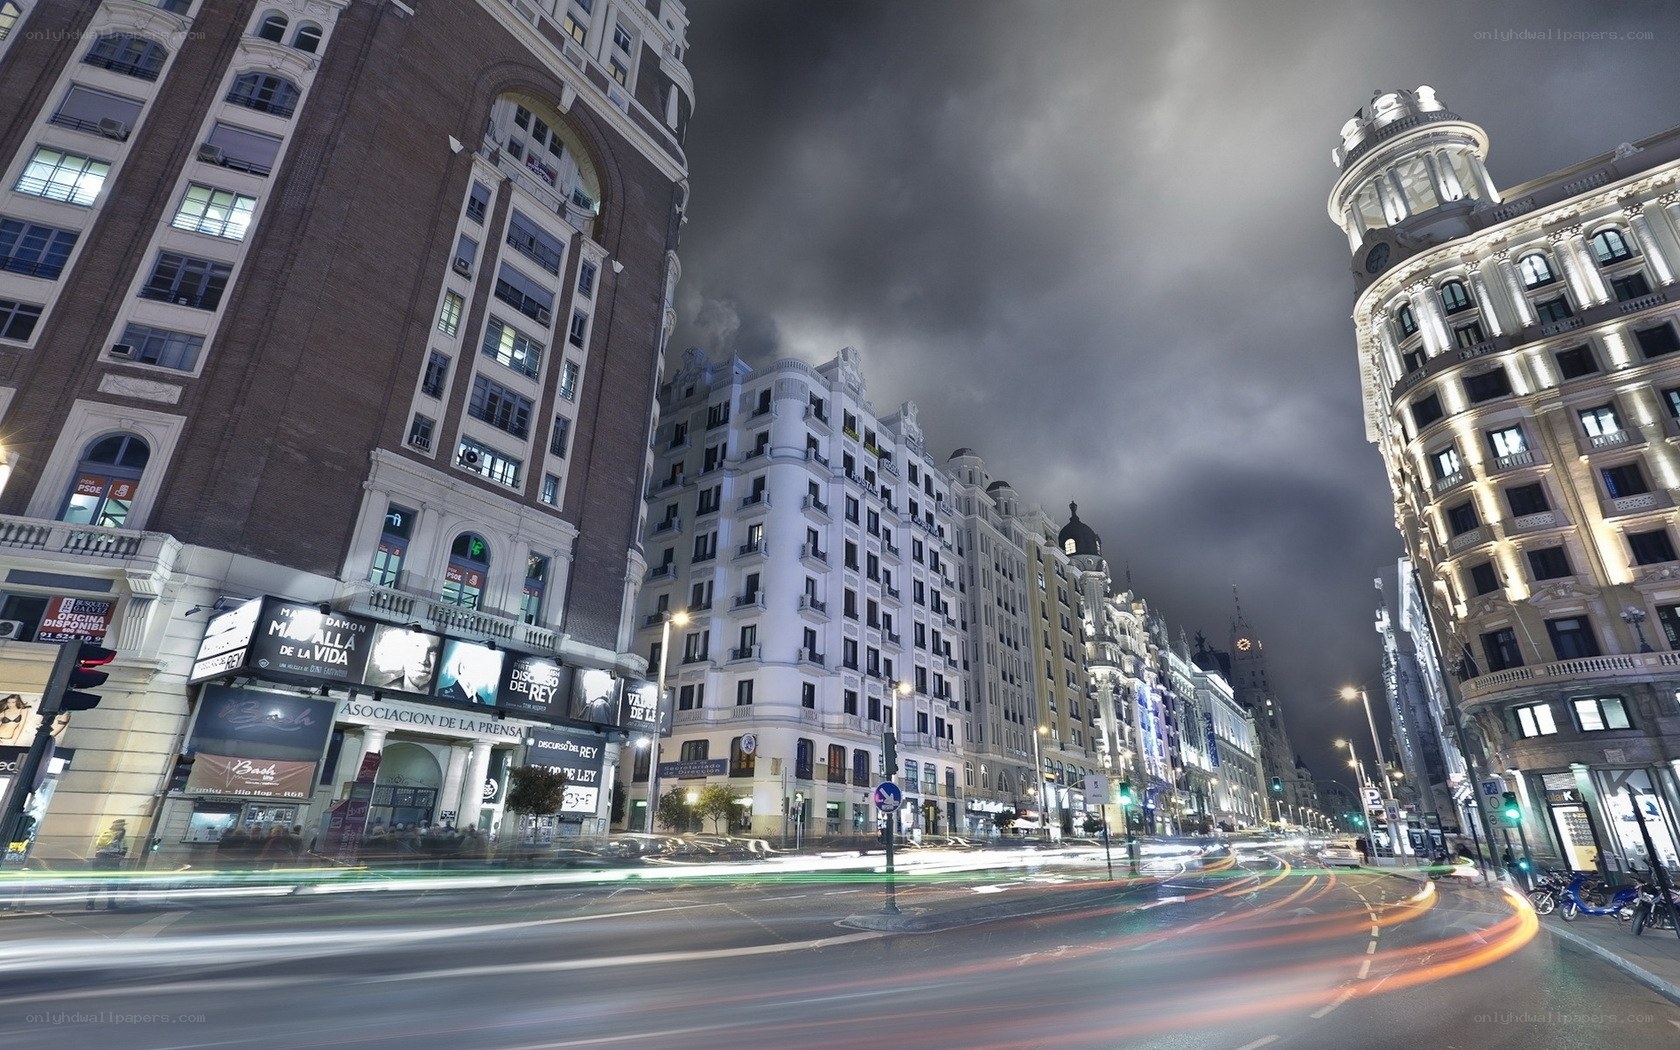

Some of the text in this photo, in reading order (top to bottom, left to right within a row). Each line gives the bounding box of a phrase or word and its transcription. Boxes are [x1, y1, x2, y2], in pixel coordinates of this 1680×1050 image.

[78, 484, 102, 493] PSOE
[43, 619, 109, 631] DISPONIBL
[57, 613, 104, 624] OFICINA
[325, 617, 366, 633] DAMON
[279, 644, 348, 666] DE LA VIDA
[509, 680, 557, 704] DEL REY
[340, 703, 523, 738] ASOCIACION DE LA PRENSA
[630, 706, 644, 720] DE
[538, 740, 598, 759] DISCURSO DEL REY
[232, 759, 276, 775] Bash
[577, 769, 596, 782] LEY
[1365, 790, 1381, 805] P
